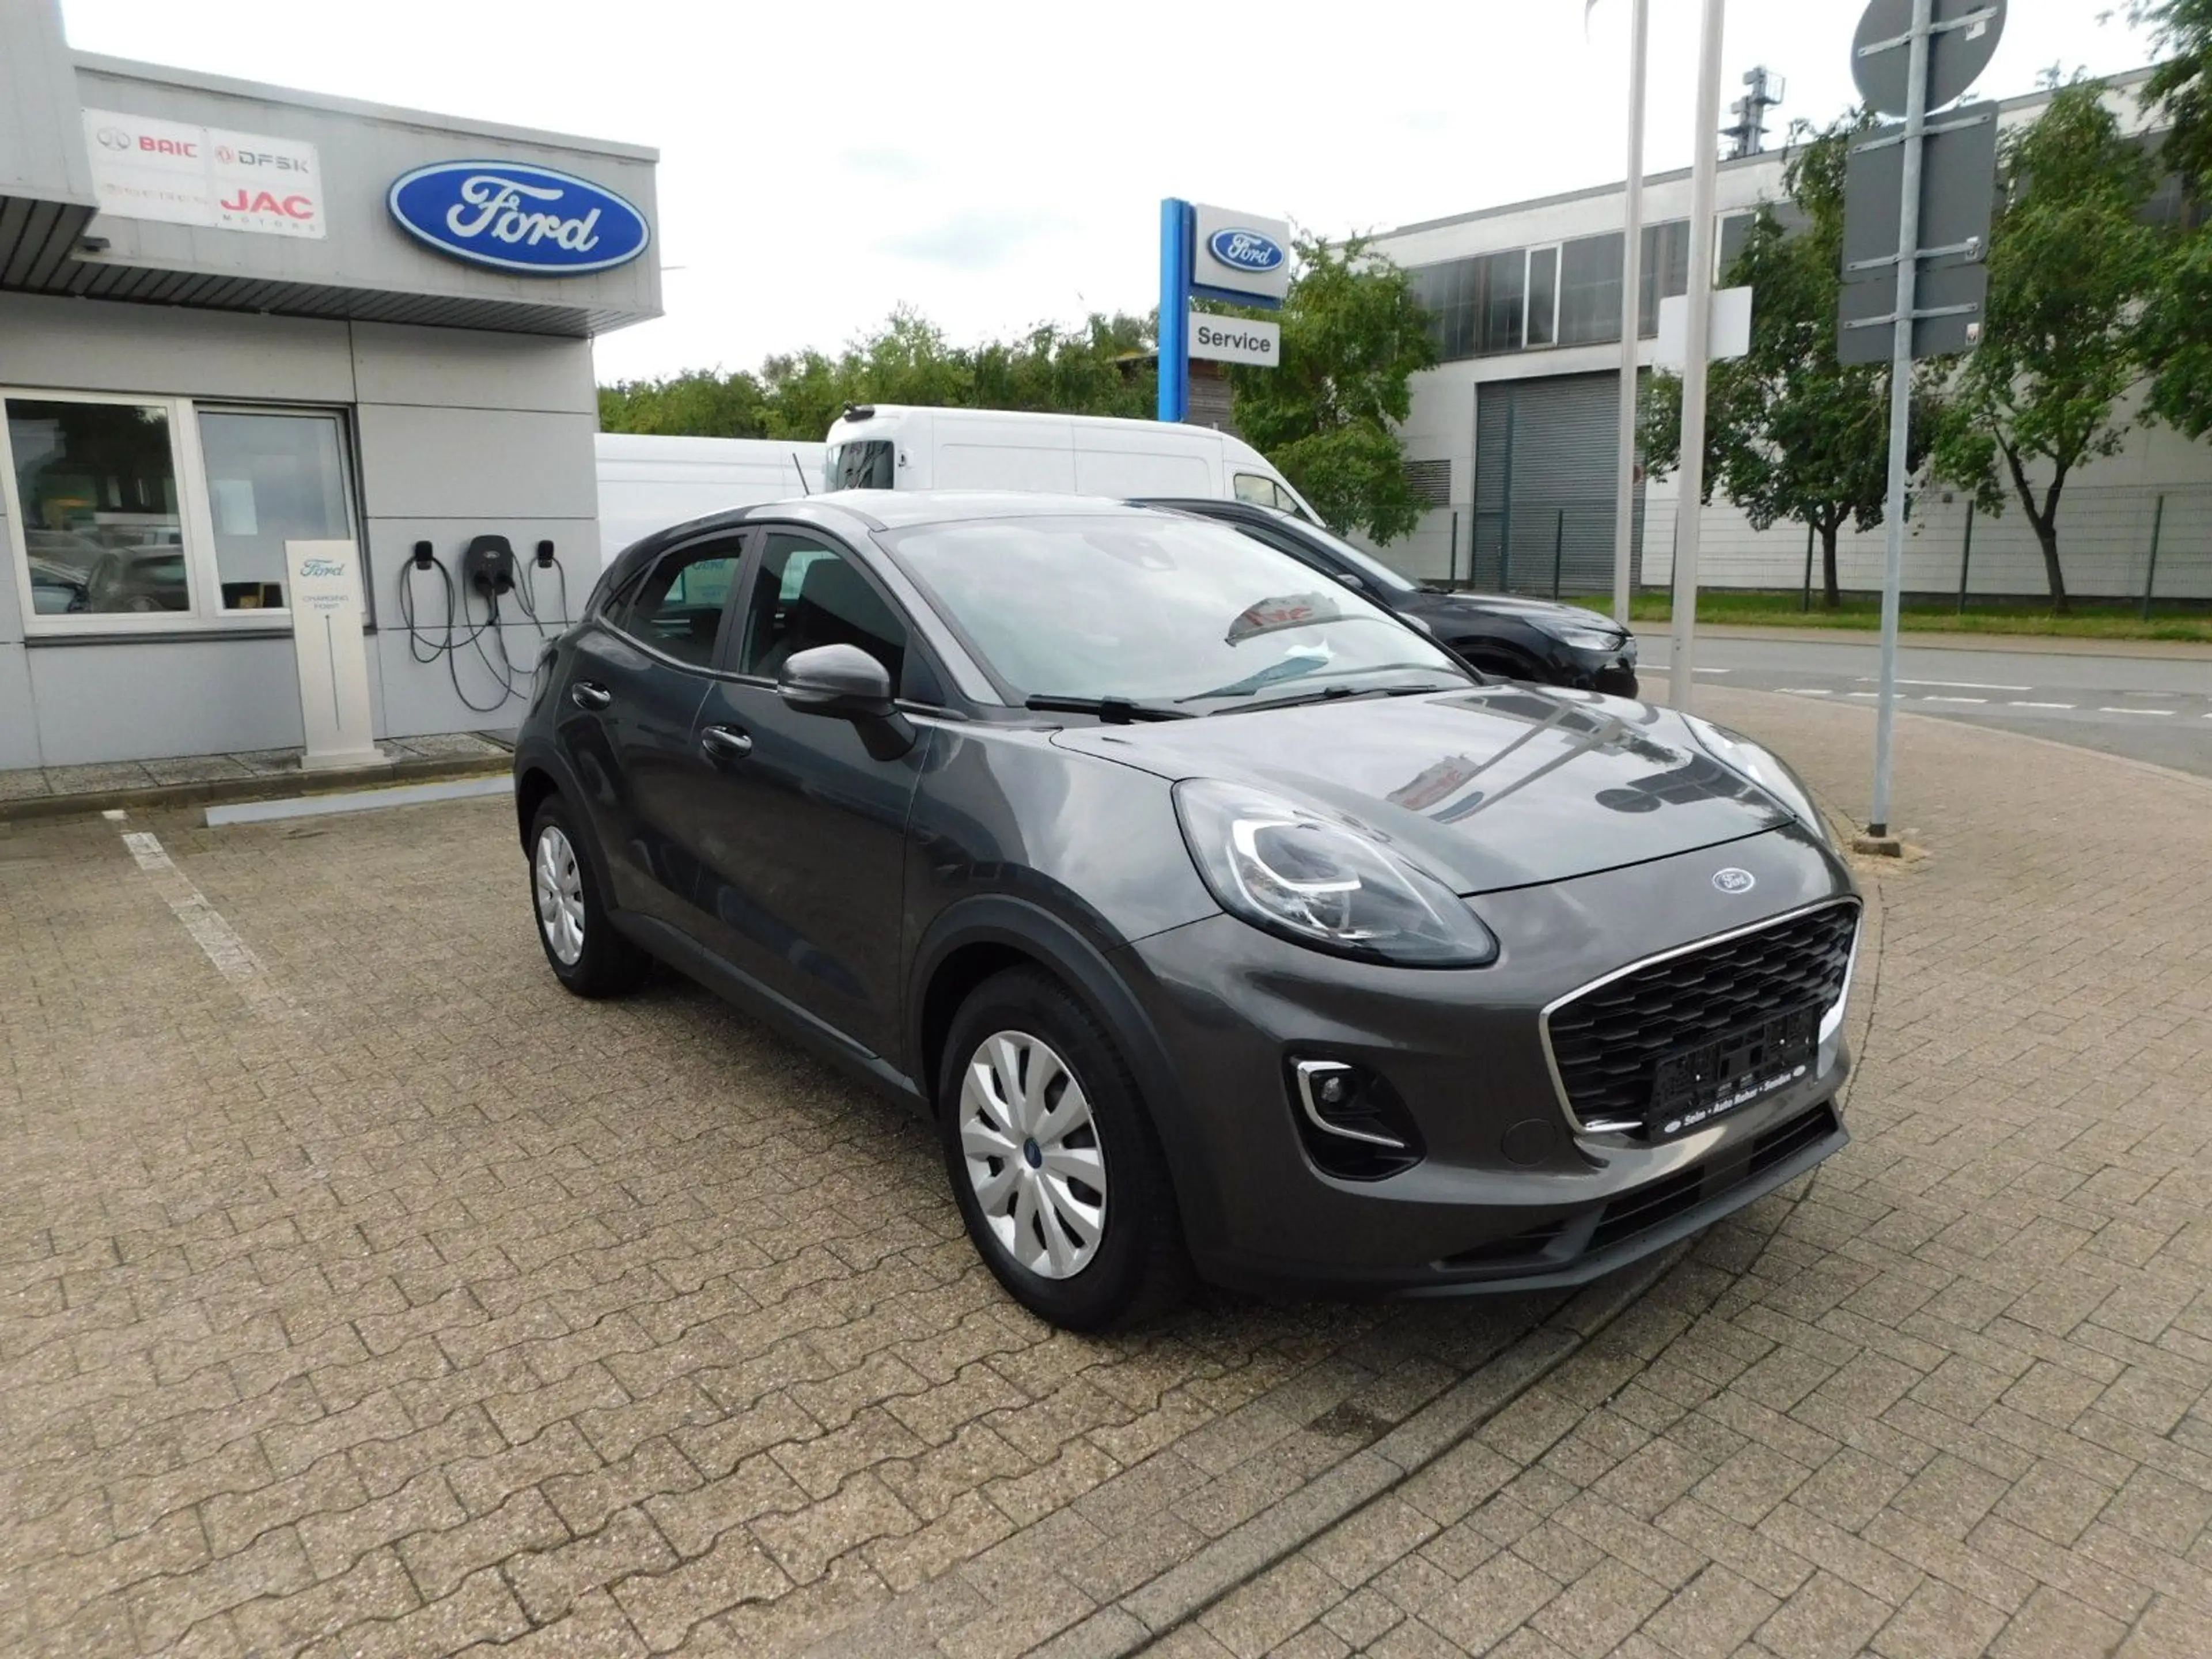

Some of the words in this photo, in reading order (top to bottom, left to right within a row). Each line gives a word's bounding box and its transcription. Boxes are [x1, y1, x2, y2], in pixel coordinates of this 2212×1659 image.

[138, 135, 198, 158] BAIC
[238, 150, 310, 173] DFSK
[220, 188, 315, 220] JAC
[446, 175, 602, 252] Ford
[1228, 233, 1272, 265] Ford
[1198, 325, 1271, 353] Service
[300, 558, 346, 577] Ford
[1713, 1098, 1733, 1113] Auto
